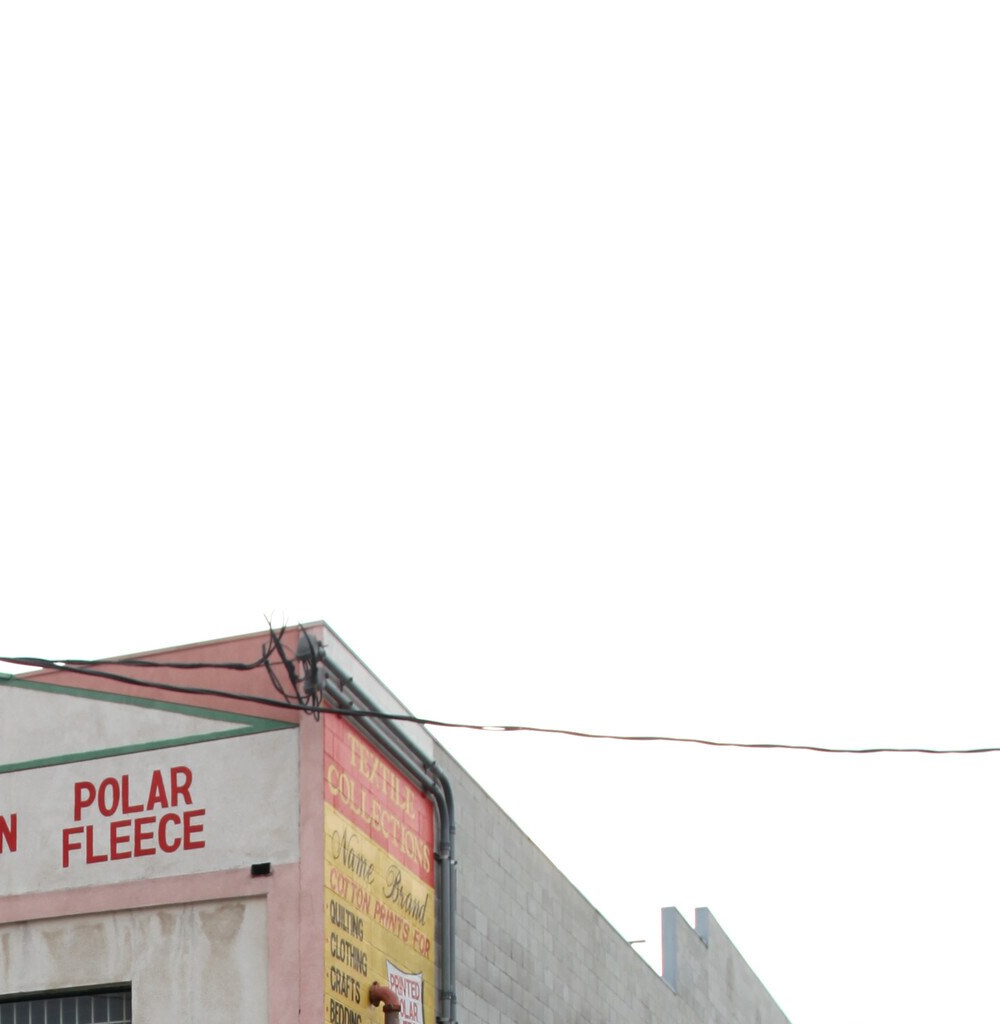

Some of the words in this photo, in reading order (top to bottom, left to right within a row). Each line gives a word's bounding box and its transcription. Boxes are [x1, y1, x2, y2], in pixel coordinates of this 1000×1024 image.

[74, 766, 193, 821] POLAR
[347, 731, 417, 819] TEXTILE
[62, 809, 205, 868] FLEECE
[327, 764, 430, 873] COLLECTIONS
[331, 827, 375, 884] Name
[382, 864, 429, 926] Brand
[329, 867, 371, 914] COTTON
[373, 900, 410, 942] PRINTS
[412, 928, 431, 959] FOR
[330, 899, 364, 942] QUILTING
[330, 932, 368, 977] CLOTHING
[329, 966, 361, 1004] CRAFTS
[389, 973, 420, 1000] PRINTED
[399, 998, 418, 1021] OLAR
